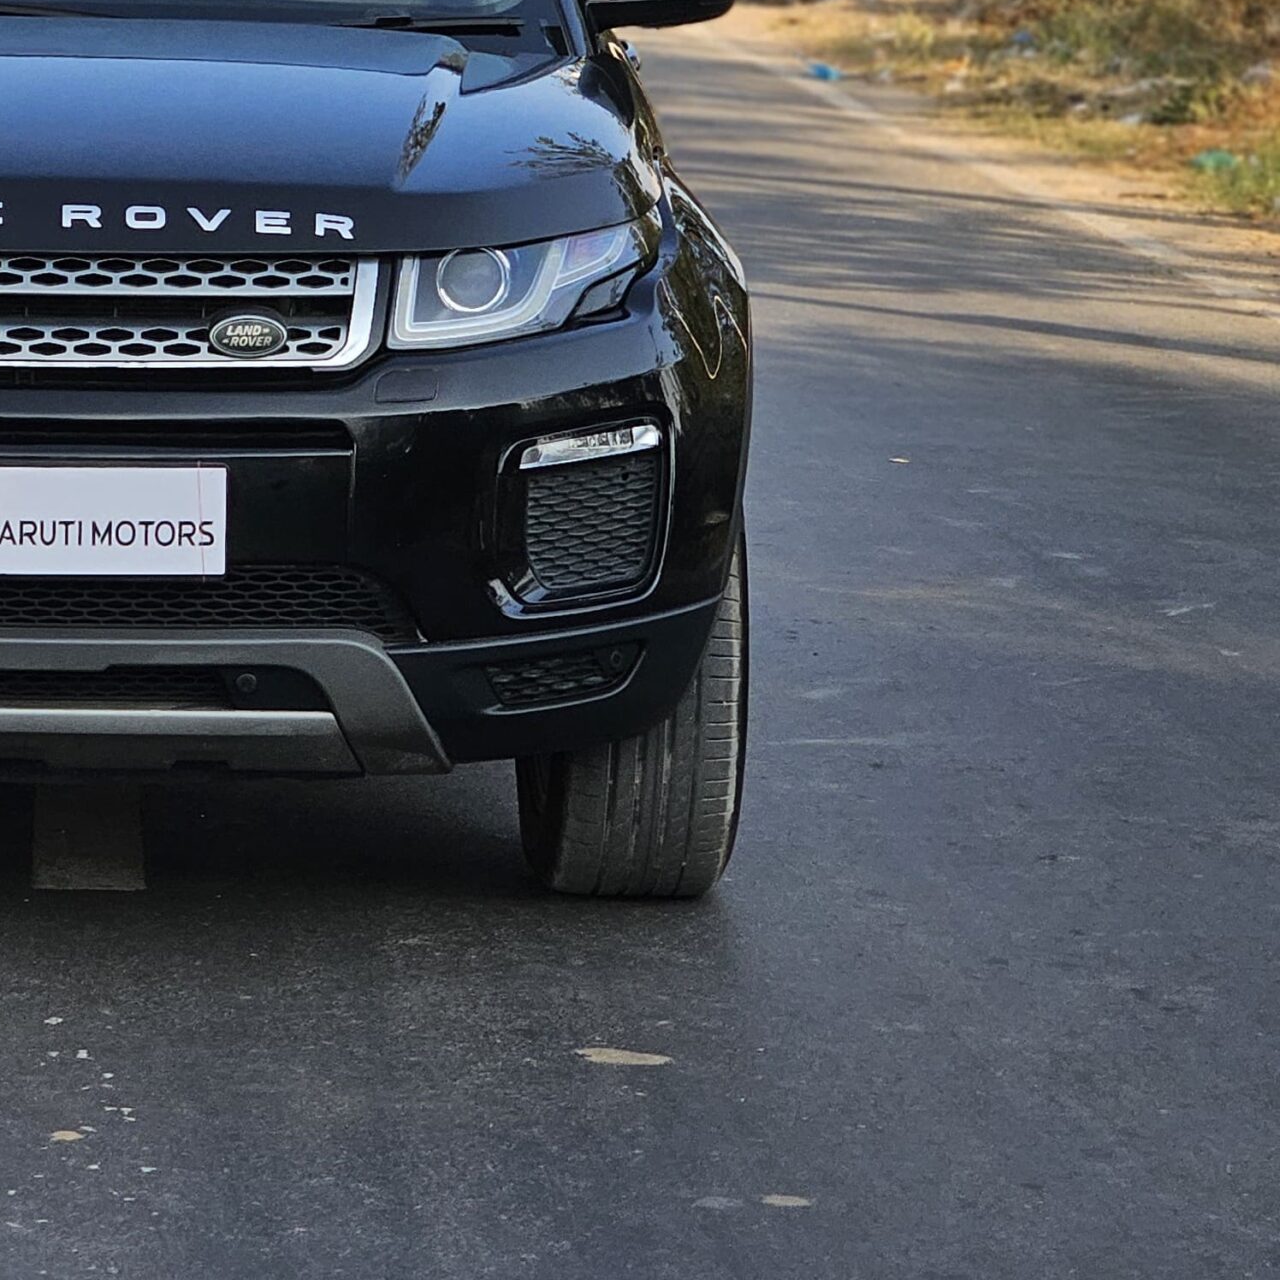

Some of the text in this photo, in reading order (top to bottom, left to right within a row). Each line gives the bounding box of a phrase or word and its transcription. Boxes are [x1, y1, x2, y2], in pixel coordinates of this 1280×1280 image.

[61, 203, 355, 239] ROVER
[226, 325, 261, 336] LAND
[229, 336, 273, 347] ROVER
[91, 520, 215, 547] MOTORS
